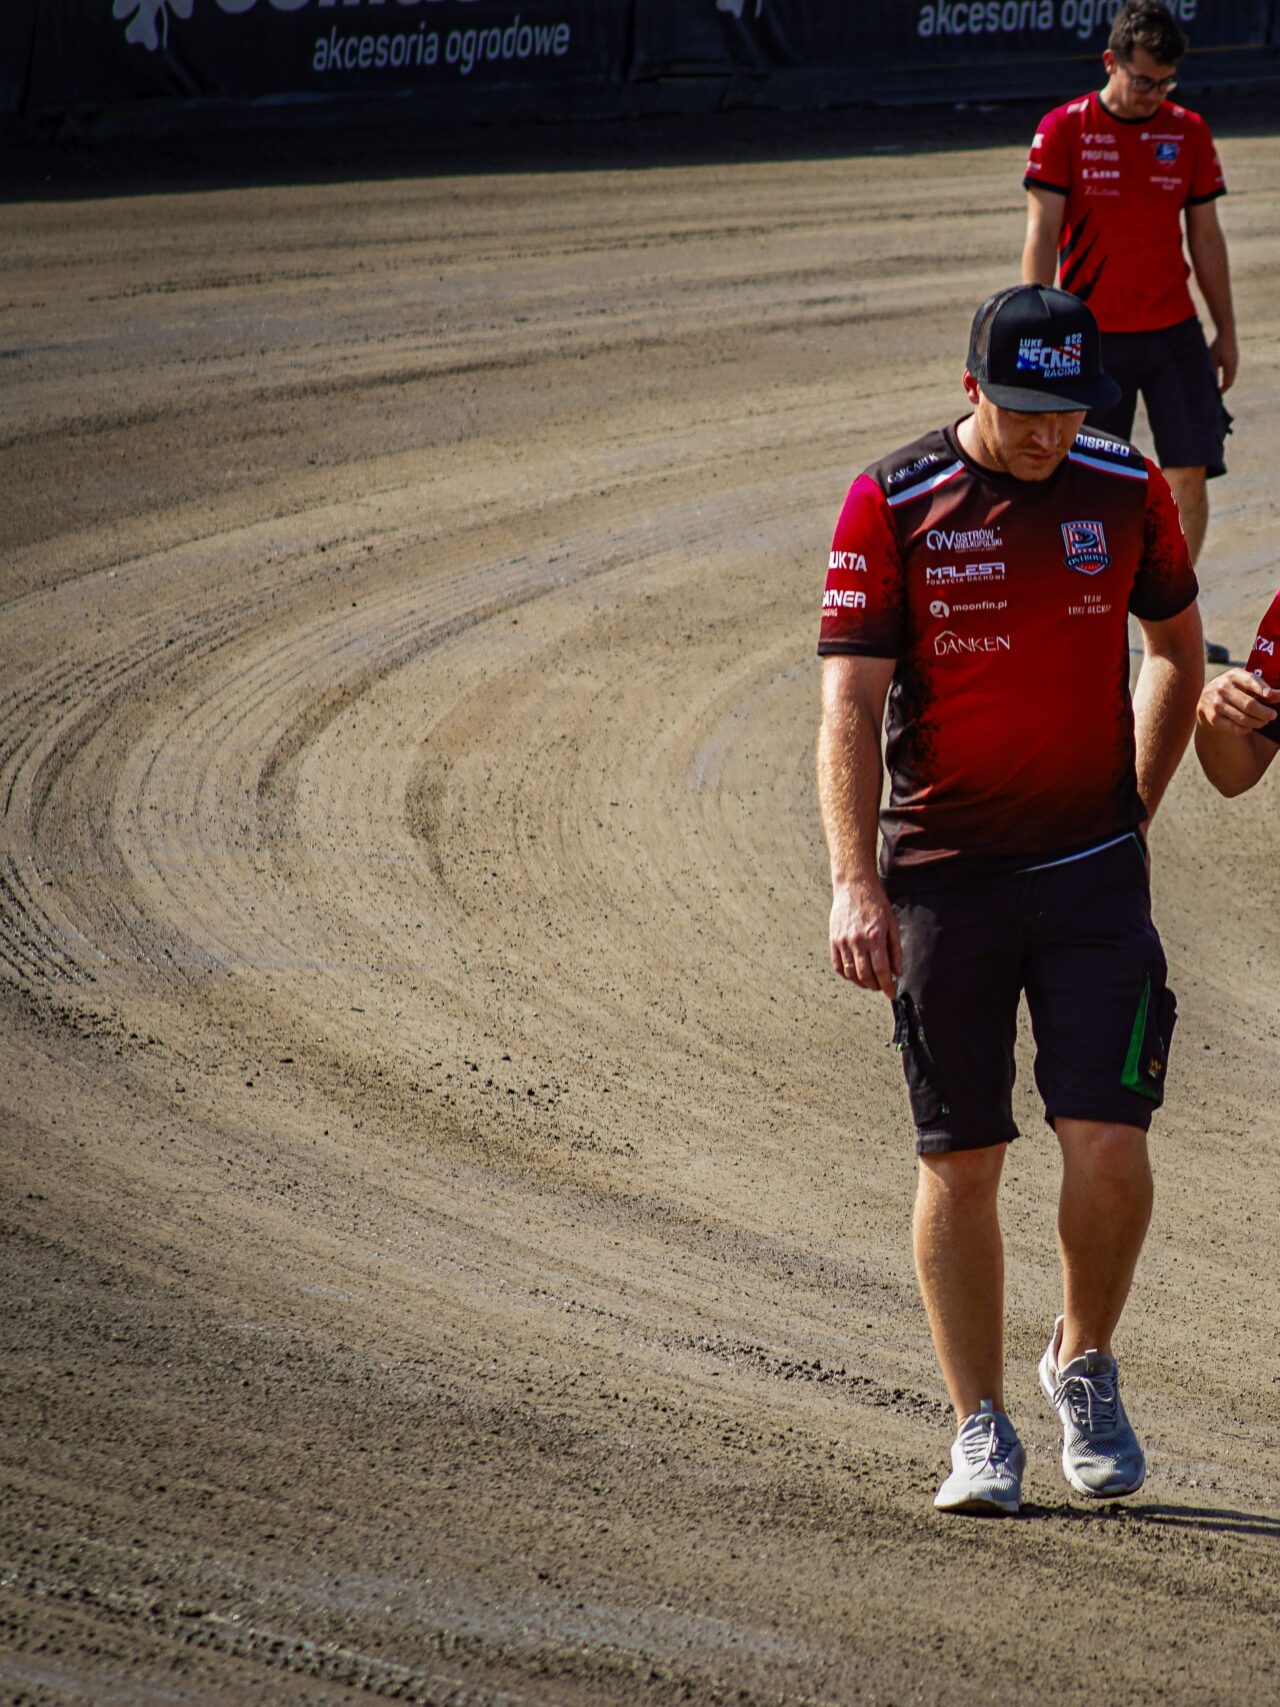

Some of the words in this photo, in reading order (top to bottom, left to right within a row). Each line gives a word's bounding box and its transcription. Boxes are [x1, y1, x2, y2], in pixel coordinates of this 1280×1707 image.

[917, 0, 1051, 37] akcesoria
[313, 22, 438, 71] akcesoria
[445, 15, 570, 74] ogrodowe
[1019, 337, 1043, 348] LUKE
[1044, 366, 1081, 379] RACING
[955, 528, 994, 542] OSTRÓW
[952, 599, 1008, 612] moonfin.pl
[934, 630, 1011, 657] DANKEN
